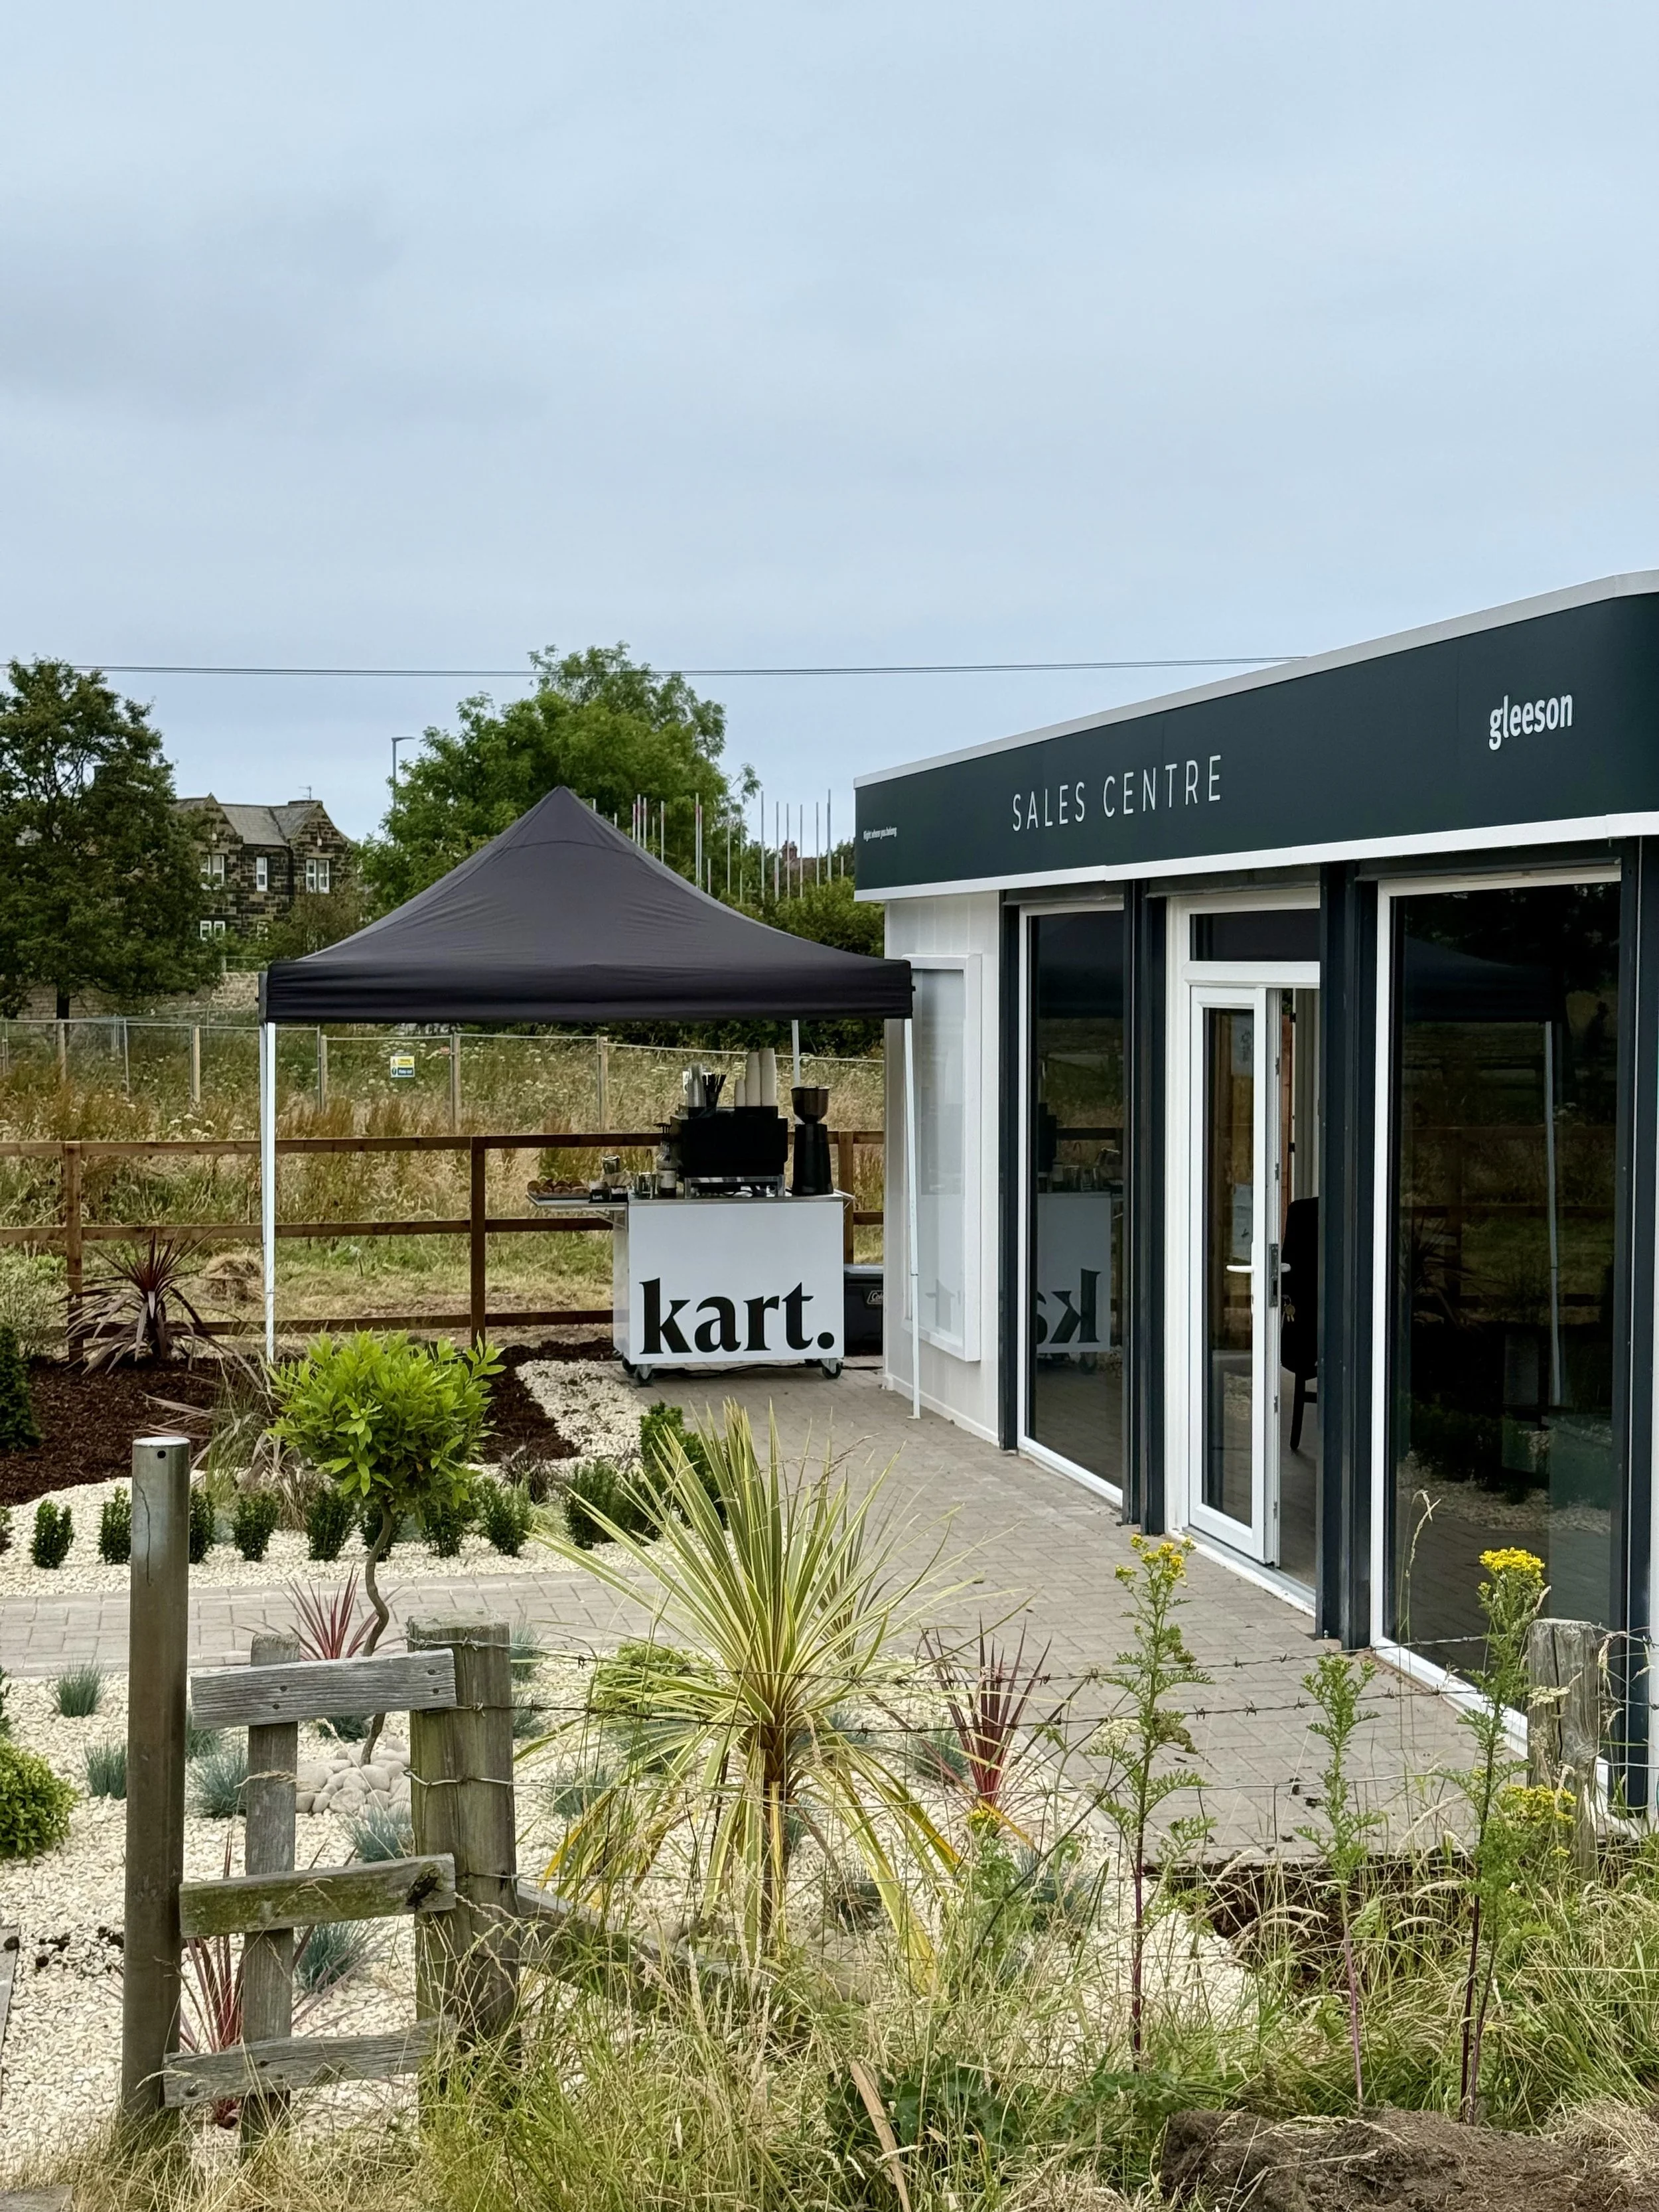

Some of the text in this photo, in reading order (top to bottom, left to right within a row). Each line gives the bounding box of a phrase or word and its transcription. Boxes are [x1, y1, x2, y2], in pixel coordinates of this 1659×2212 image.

[1488, 694, 1573, 751] gleeson
[1013, 755, 1222, 832] SALES CENTRE
[639, 1277, 835, 1355] kart.
